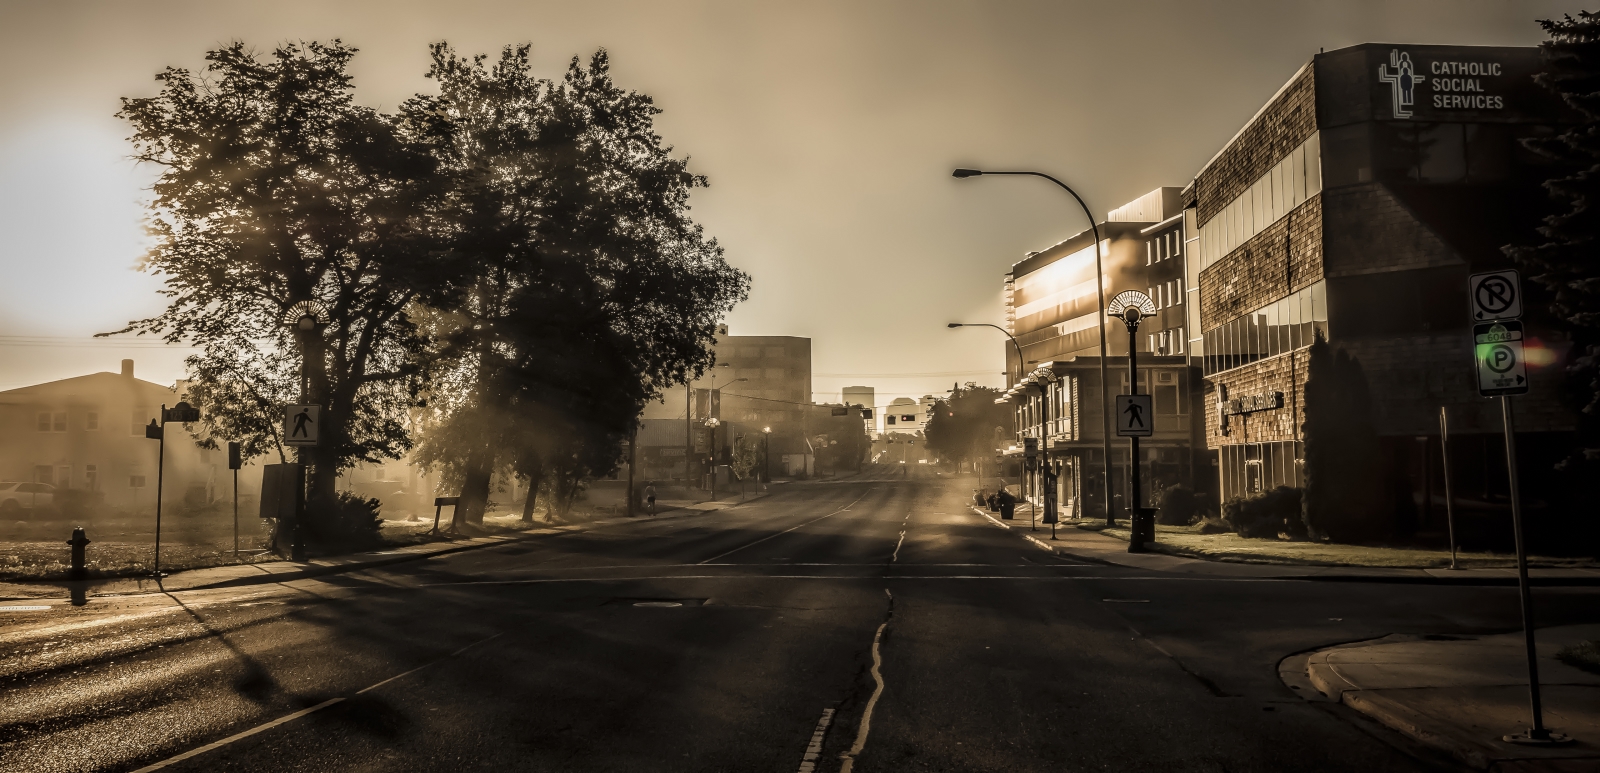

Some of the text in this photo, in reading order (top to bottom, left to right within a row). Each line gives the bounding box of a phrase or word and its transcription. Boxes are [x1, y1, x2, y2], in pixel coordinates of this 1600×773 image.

[1431, 61, 1502, 76] CATHOLIC
[1432, 78, 1485, 93] SOCIAL
[1433, 94, 1504, 110] SERVICES
[1487, 331, 1512, 342] 6048
[1494, 350, 1508, 368] P
[169, 410, 183, 421] 125
